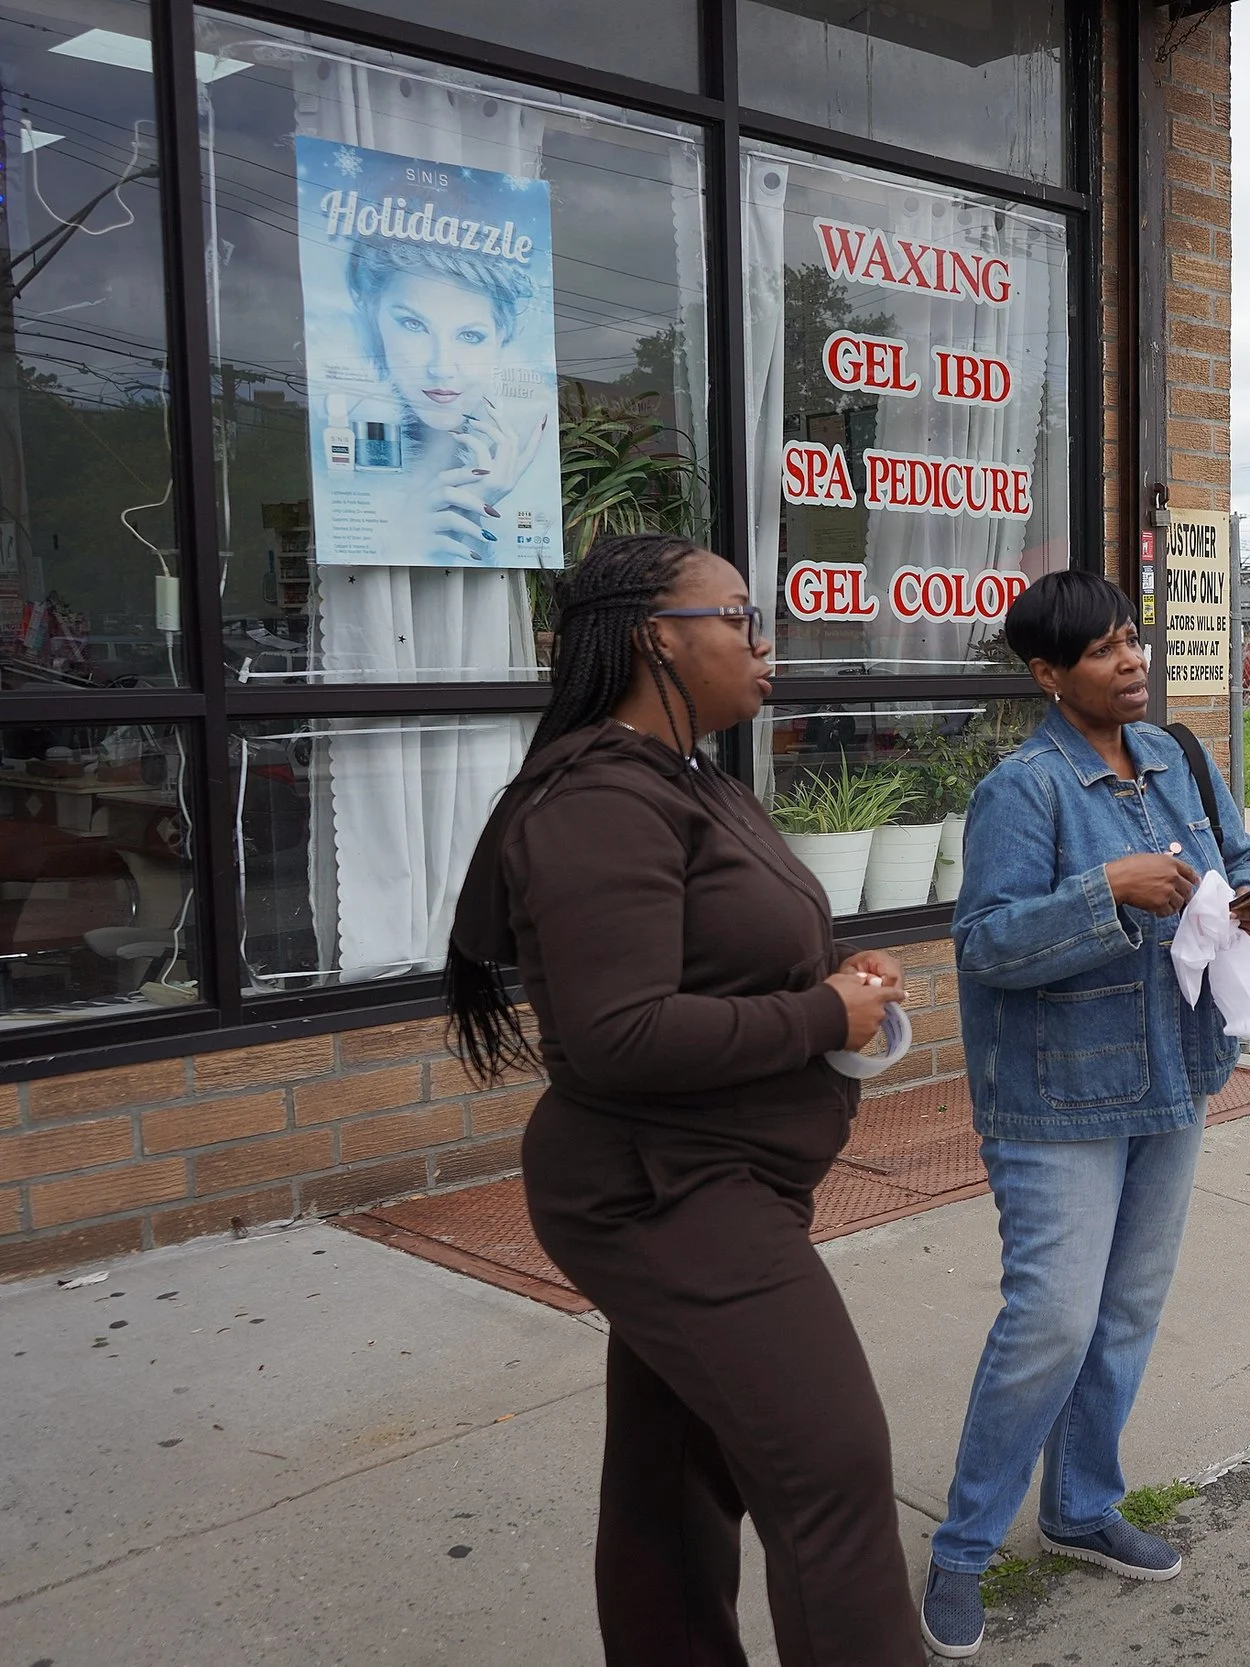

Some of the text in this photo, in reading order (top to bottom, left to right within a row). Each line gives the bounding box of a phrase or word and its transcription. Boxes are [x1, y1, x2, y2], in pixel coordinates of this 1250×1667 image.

[320, 190, 533, 265] Holidazzle
[818, 223, 1012, 303] WAXING
[492, 367, 543, 384] Fall into
[827, 336, 1012, 403] GEL IBD
[493, 383, 535, 399] Winter
[785, 447, 1031, 515] SPA PEDICURE
[789, 566, 876, 615] GEL
[1200, 570, 1225, 605] ONLY
[1196, 616, 1215, 632] WILL
[1216, 616, 1227, 632] BE
[1187, 641, 1210, 656] AWAY
[1209, 641, 1220, 656] AT
[1190, 665, 1224, 681] EXPENSE
